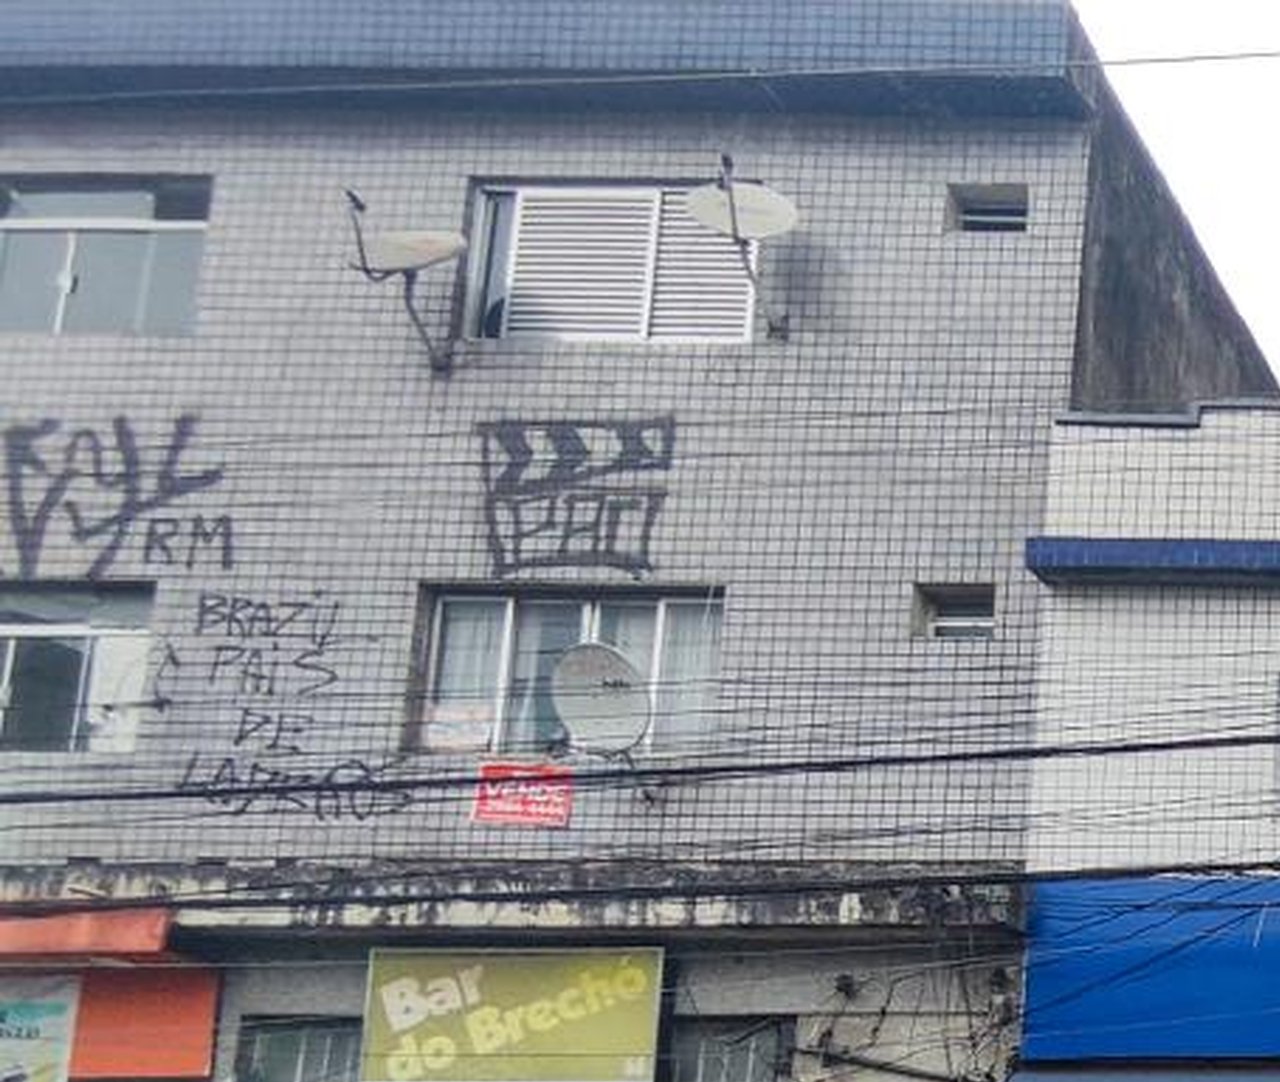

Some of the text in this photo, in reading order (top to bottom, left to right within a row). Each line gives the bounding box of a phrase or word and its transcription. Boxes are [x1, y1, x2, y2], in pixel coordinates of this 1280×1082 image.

[381, 964, 485, 1032] Bar
[386, 955, 648, 1081] do Brechó
